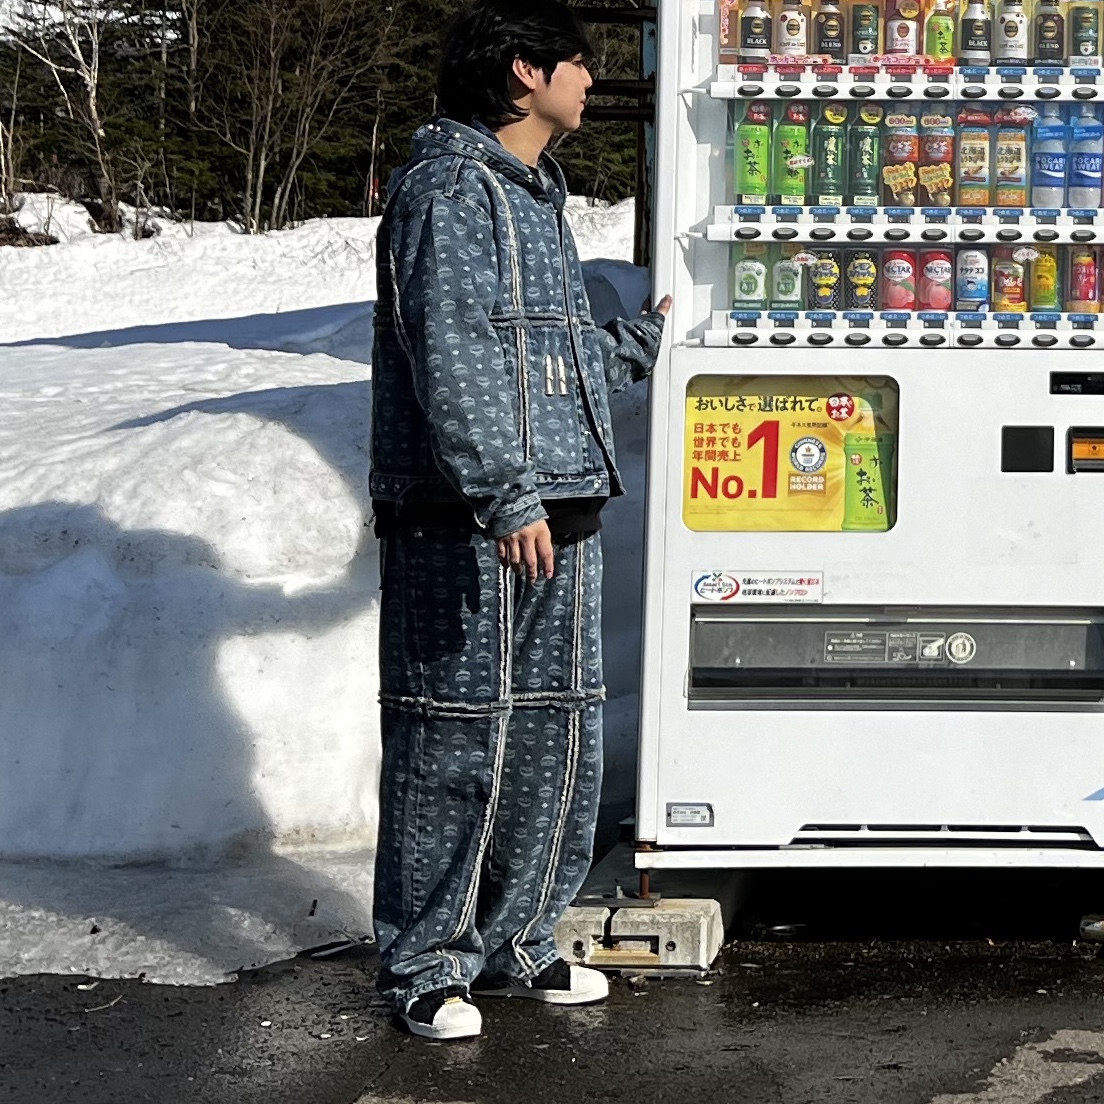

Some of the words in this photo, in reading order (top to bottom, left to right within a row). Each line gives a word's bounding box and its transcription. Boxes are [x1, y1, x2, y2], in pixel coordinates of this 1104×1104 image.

[884, 266, 911, 275] NECTAR
[694, 397, 823, 413] おいしさで選ばれて。
[693, 422, 742, 435] 日本でも
[692, 436, 742, 449] 世界でも
[691, 450, 742, 463] 年間売上
[790, 475, 825, 484] RECORD
[789, 483, 825, 492] HOLDER
[856, 468, 879, 509] お茶
